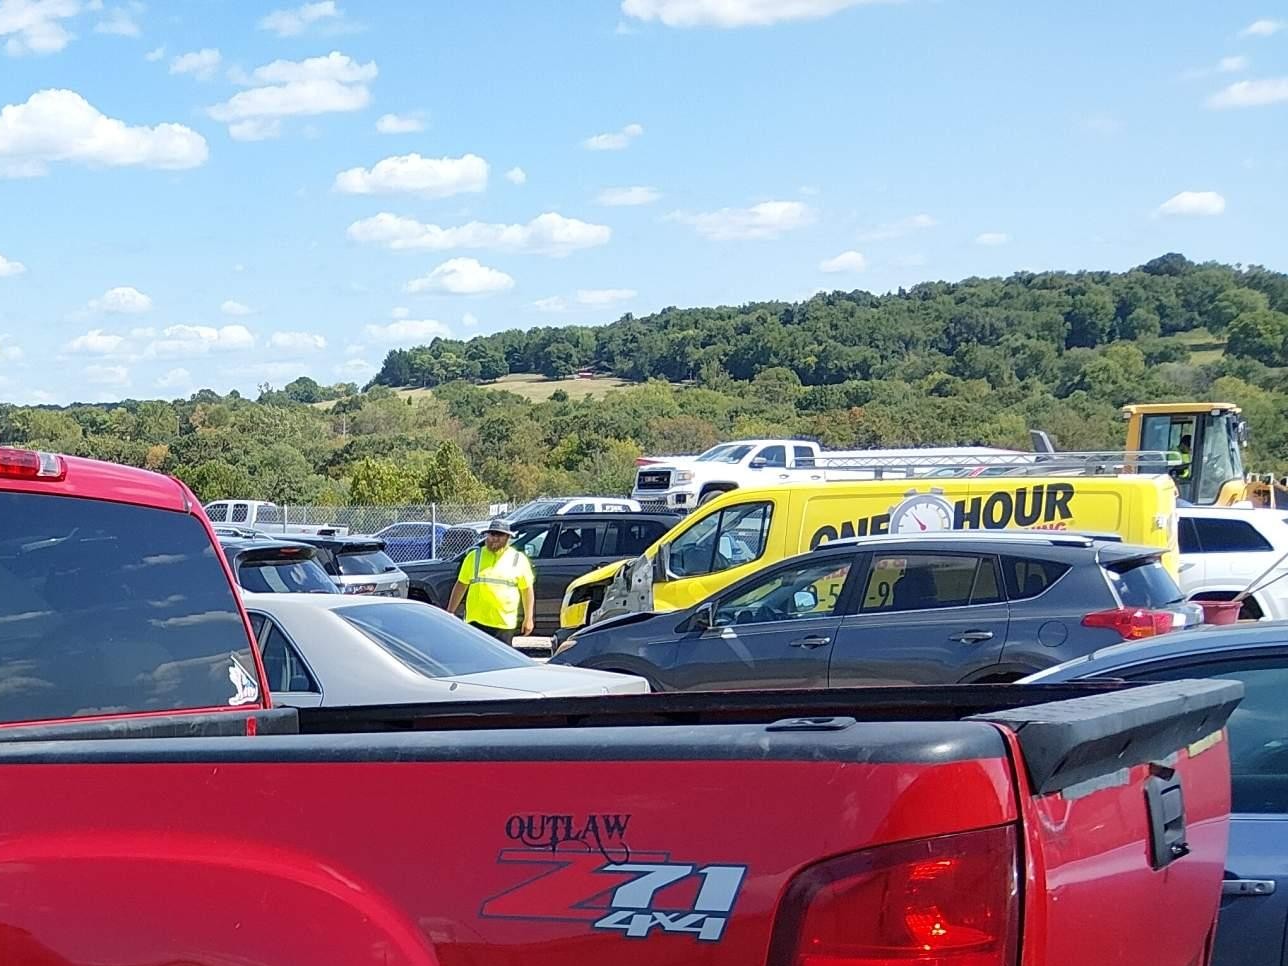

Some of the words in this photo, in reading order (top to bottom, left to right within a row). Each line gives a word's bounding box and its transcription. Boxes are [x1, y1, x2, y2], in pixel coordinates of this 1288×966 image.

[953, 483, 1075, 530] HOUR
[505, 814, 632, 860] OUTLAW
[478, 848, 748, 922] Z71
